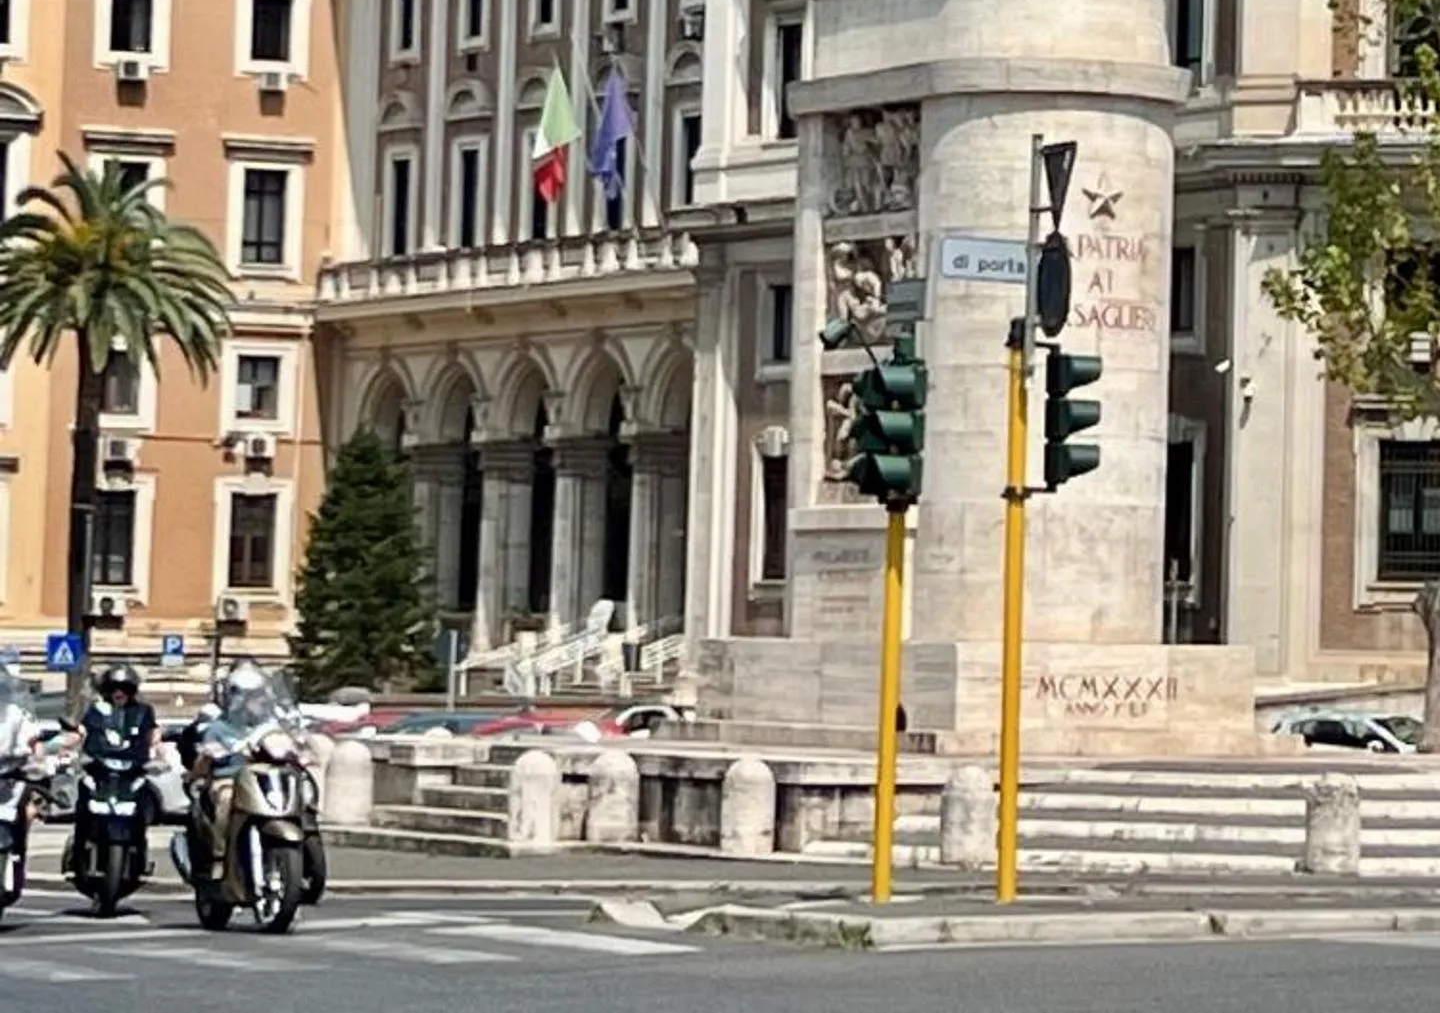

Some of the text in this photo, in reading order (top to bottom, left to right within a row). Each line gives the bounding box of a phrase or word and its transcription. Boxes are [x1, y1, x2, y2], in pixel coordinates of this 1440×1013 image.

[952, 254, 970, 269] di
[1087, 269, 1114, 294] AI
[166, 637, 181, 653] P
[1035, 675, 1178, 701] MCMXXXII
